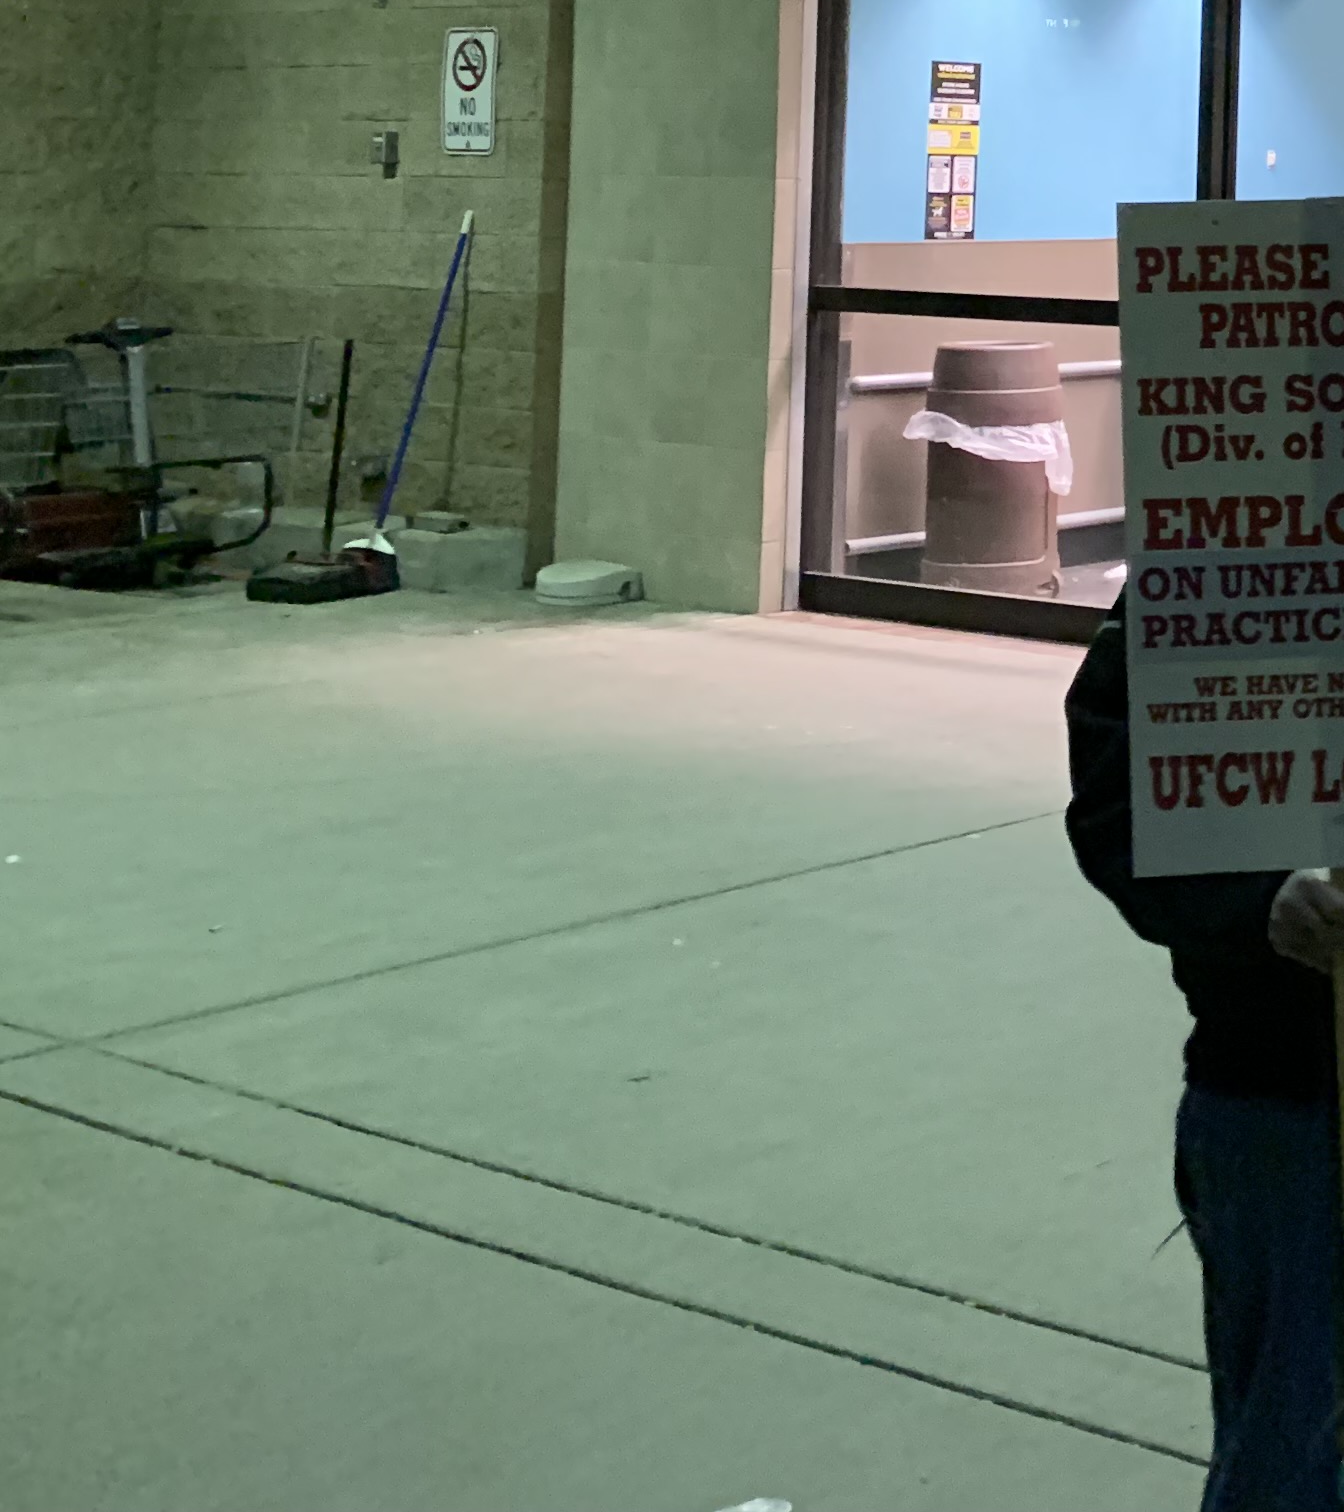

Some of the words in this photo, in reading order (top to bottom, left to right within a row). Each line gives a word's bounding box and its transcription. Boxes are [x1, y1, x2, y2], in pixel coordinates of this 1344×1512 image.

[459, 97, 477, 116] NO
[446, 122, 490, 137] SMOKING
[1135, 244, 1330, 293] PLEASE
[1137, 375, 1266, 416] KING
[1162, 424, 1265, 469] (Div.
[1283, 420, 1324, 460] of
[1138, 566, 1206, 602] ON
[1194, 675, 1236, 697] WE
[1245, 673, 1318, 695] HAVE
[1147, 702, 1217, 723] WITH
[1226, 699, 1284, 721] ANY
[1149, 750, 1295, 810] UFCW
